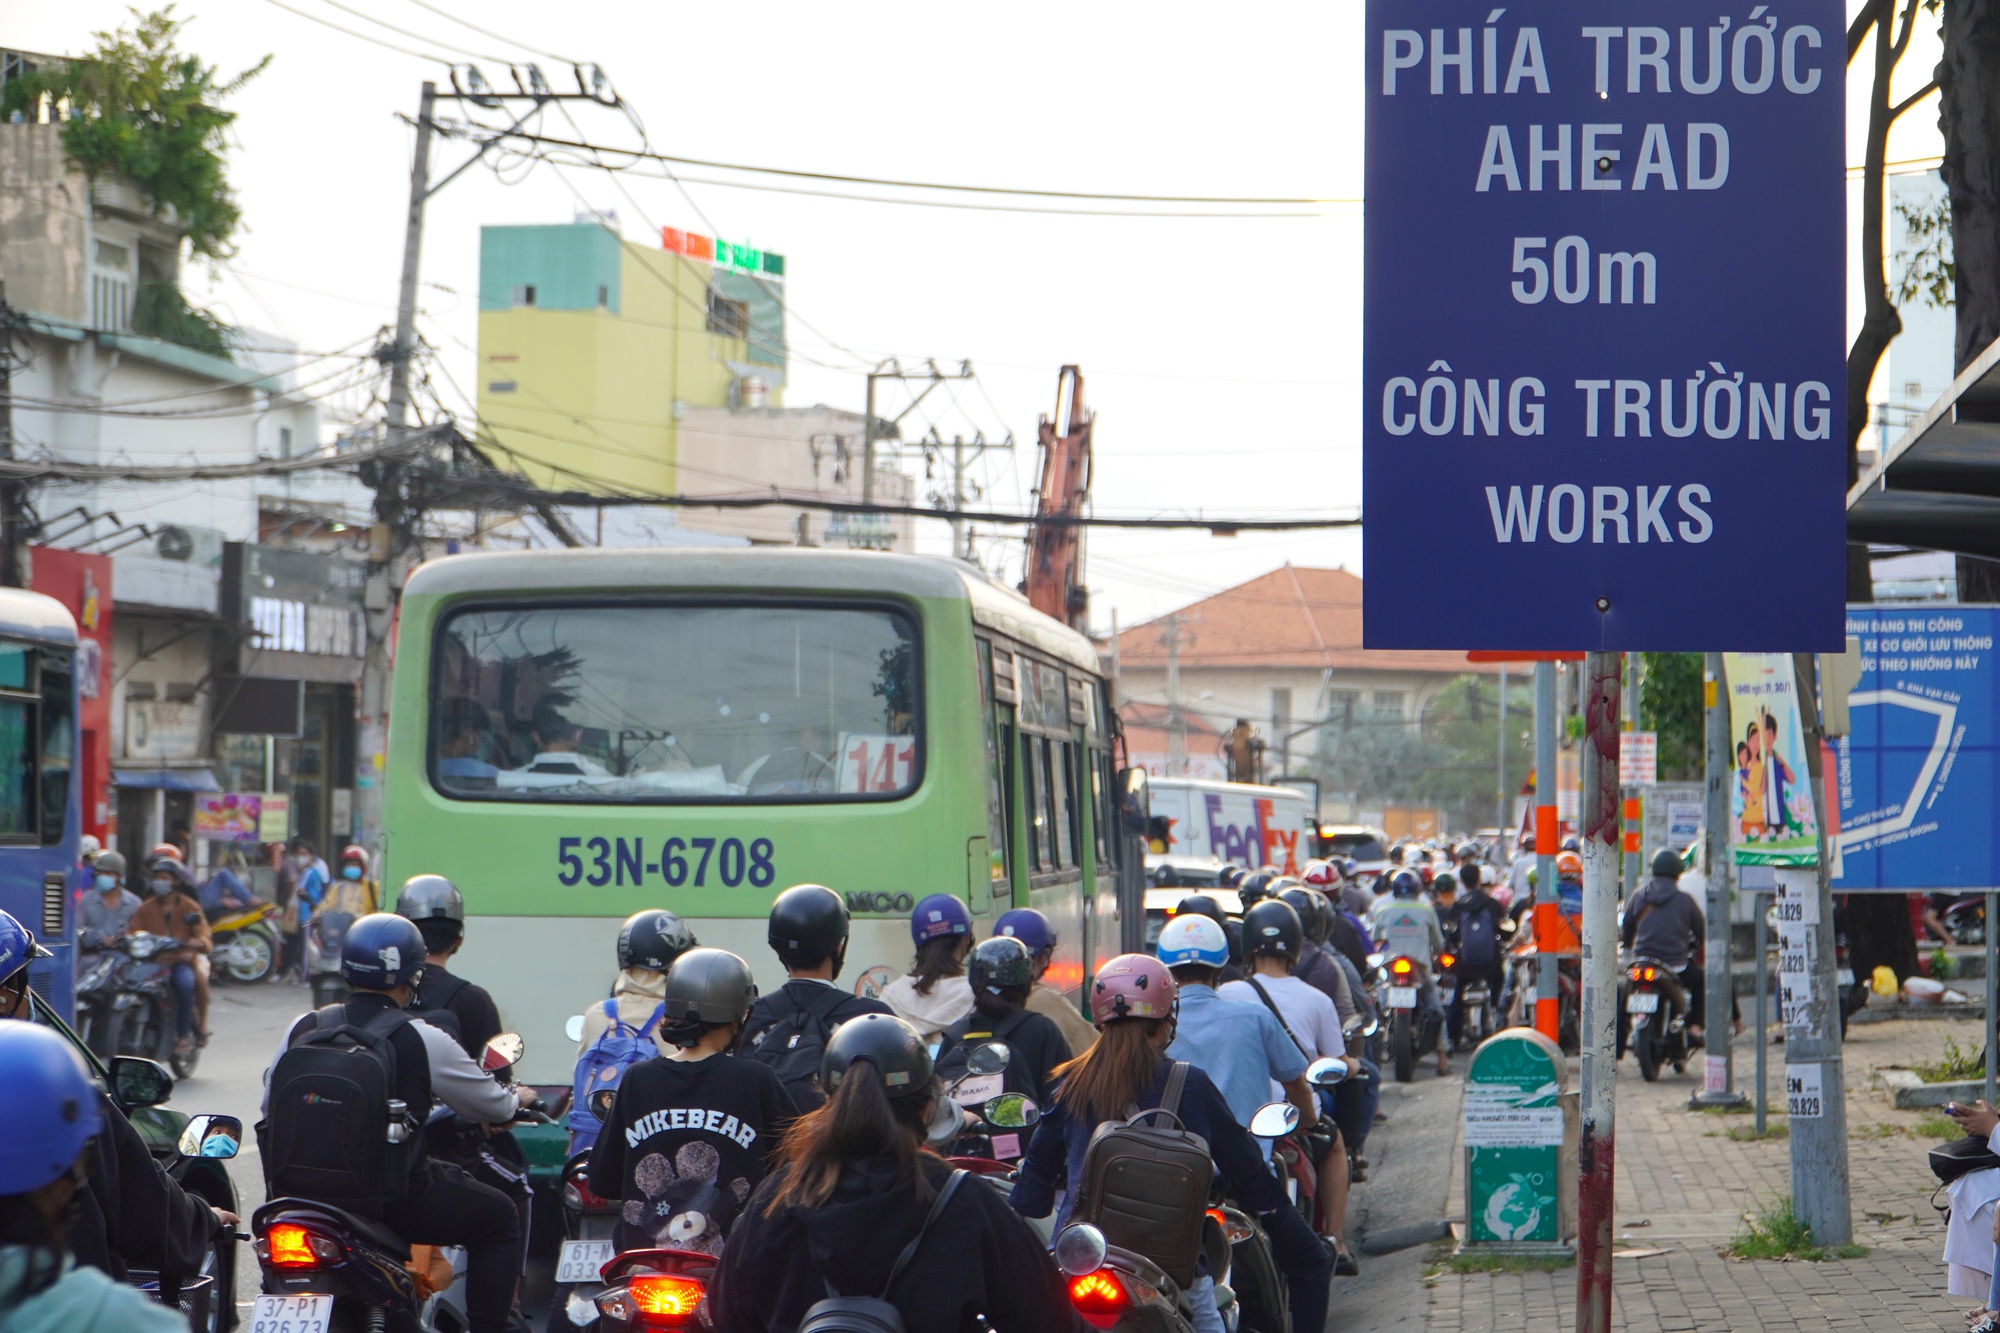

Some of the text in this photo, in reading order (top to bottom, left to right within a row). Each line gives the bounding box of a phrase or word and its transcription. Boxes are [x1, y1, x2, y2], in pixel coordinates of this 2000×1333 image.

[1382, 5, 1823, 96] PHÍA TRƯỚC
[1475, 122, 1731, 192] AHEAD
[1511, 235, 1657, 304] 50m
[1382, 359, 1832, 441] CÔNG TRƯỜNG
[1485, 483, 1714, 544] WORKS
[1864, 640, 1878, 653] XE
[1902, 635, 1927, 652] GIỚI
[1953, 633, 1993, 650] THÔNG
[1907, 620, 1925, 632] THI
[1927, 616, 1963, 632] CÔNG
[1880, 659, 1908, 671] THEO
[1910, 655, 1953, 671] HƯỚNG
[848, 741, 914, 794] 141
[558, 837, 776, 888] 53N-6708
[1204, 794, 1299, 878] FedEx
[625, 1109, 757, 1150] MIKEBEAR
[263, 1297, 319, 1318] 37-P1
